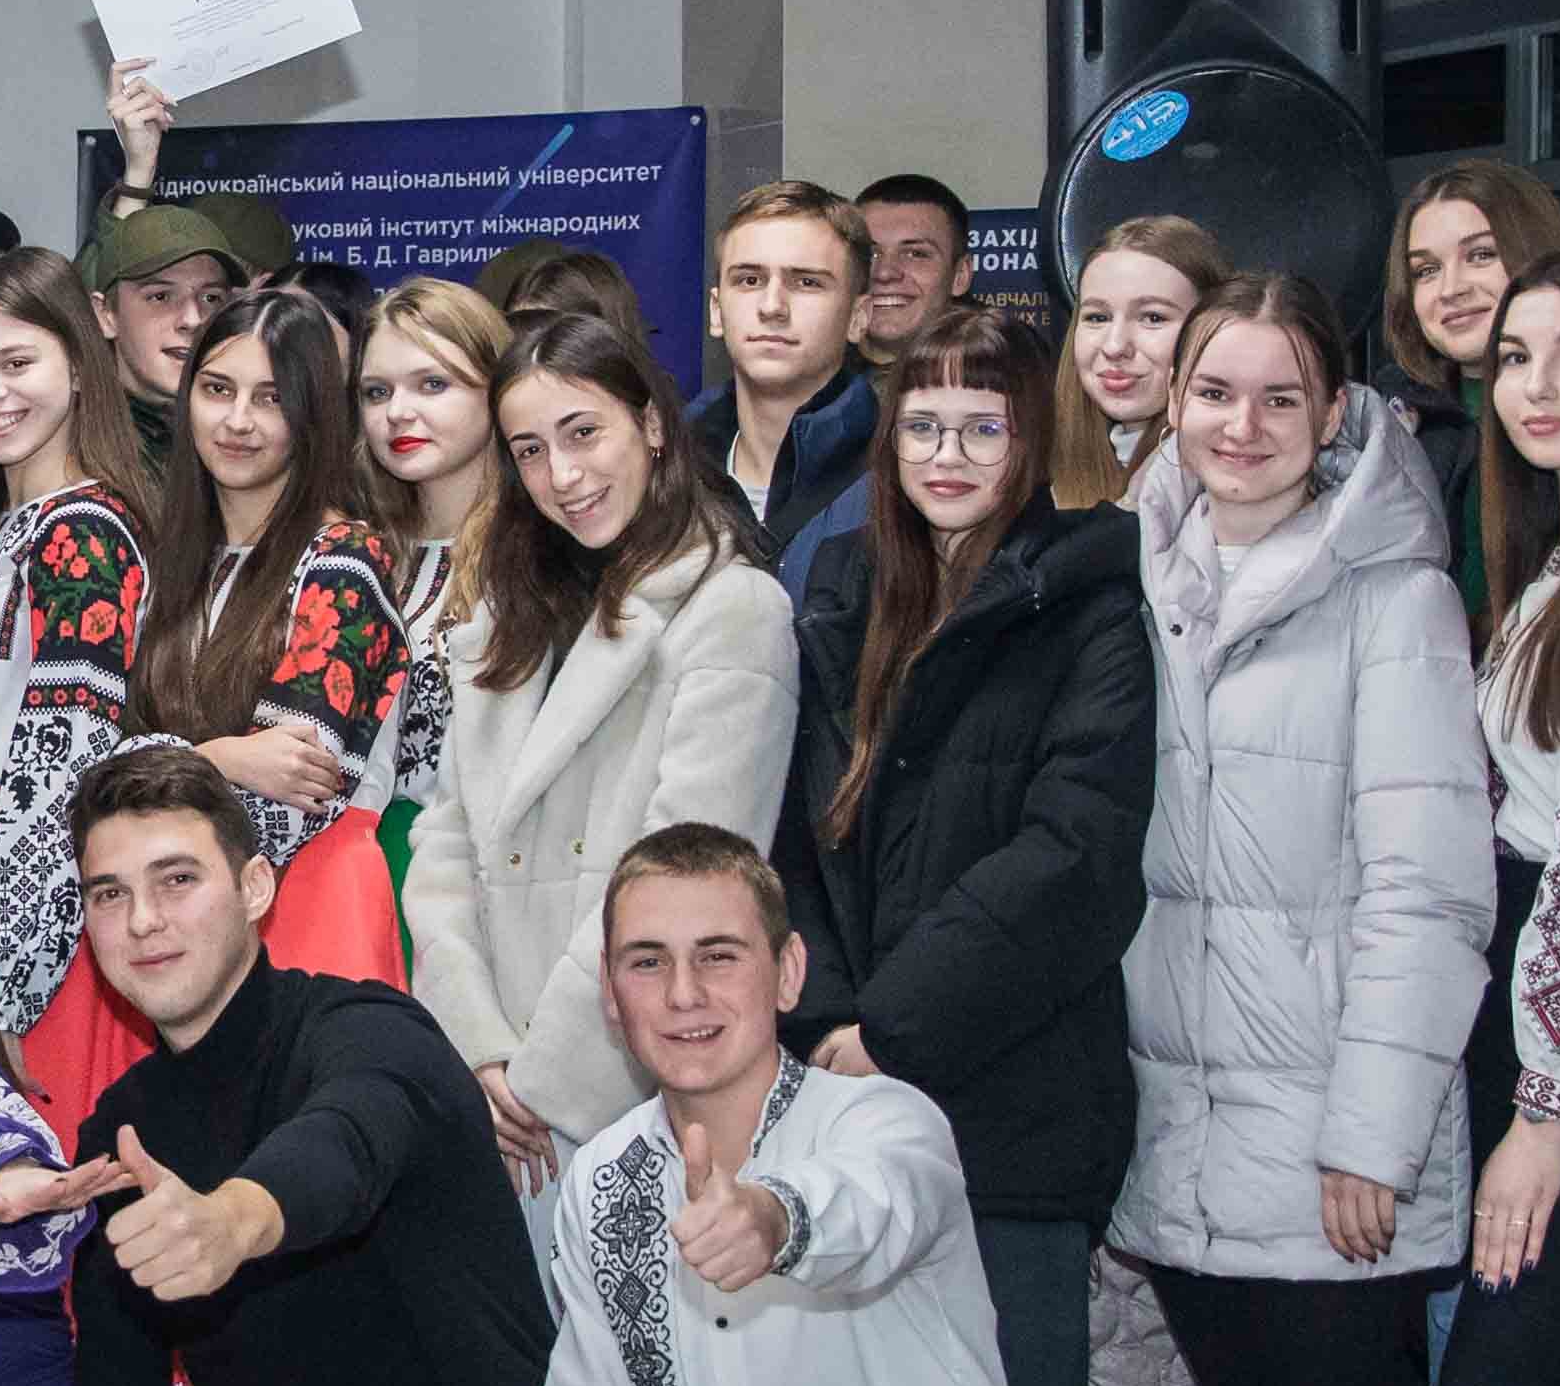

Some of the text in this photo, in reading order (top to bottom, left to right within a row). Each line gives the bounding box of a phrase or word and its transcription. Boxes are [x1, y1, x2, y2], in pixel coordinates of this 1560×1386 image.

[351, 166, 510, 193] національний
[519, 165, 662, 189] університет
[292, 214, 641, 241] уковий інститут міжнародних
[347, 246, 367, 265] Б.
[374, 245, 397, 268] Д.
[405, 246, 507, 267] Гаврили
